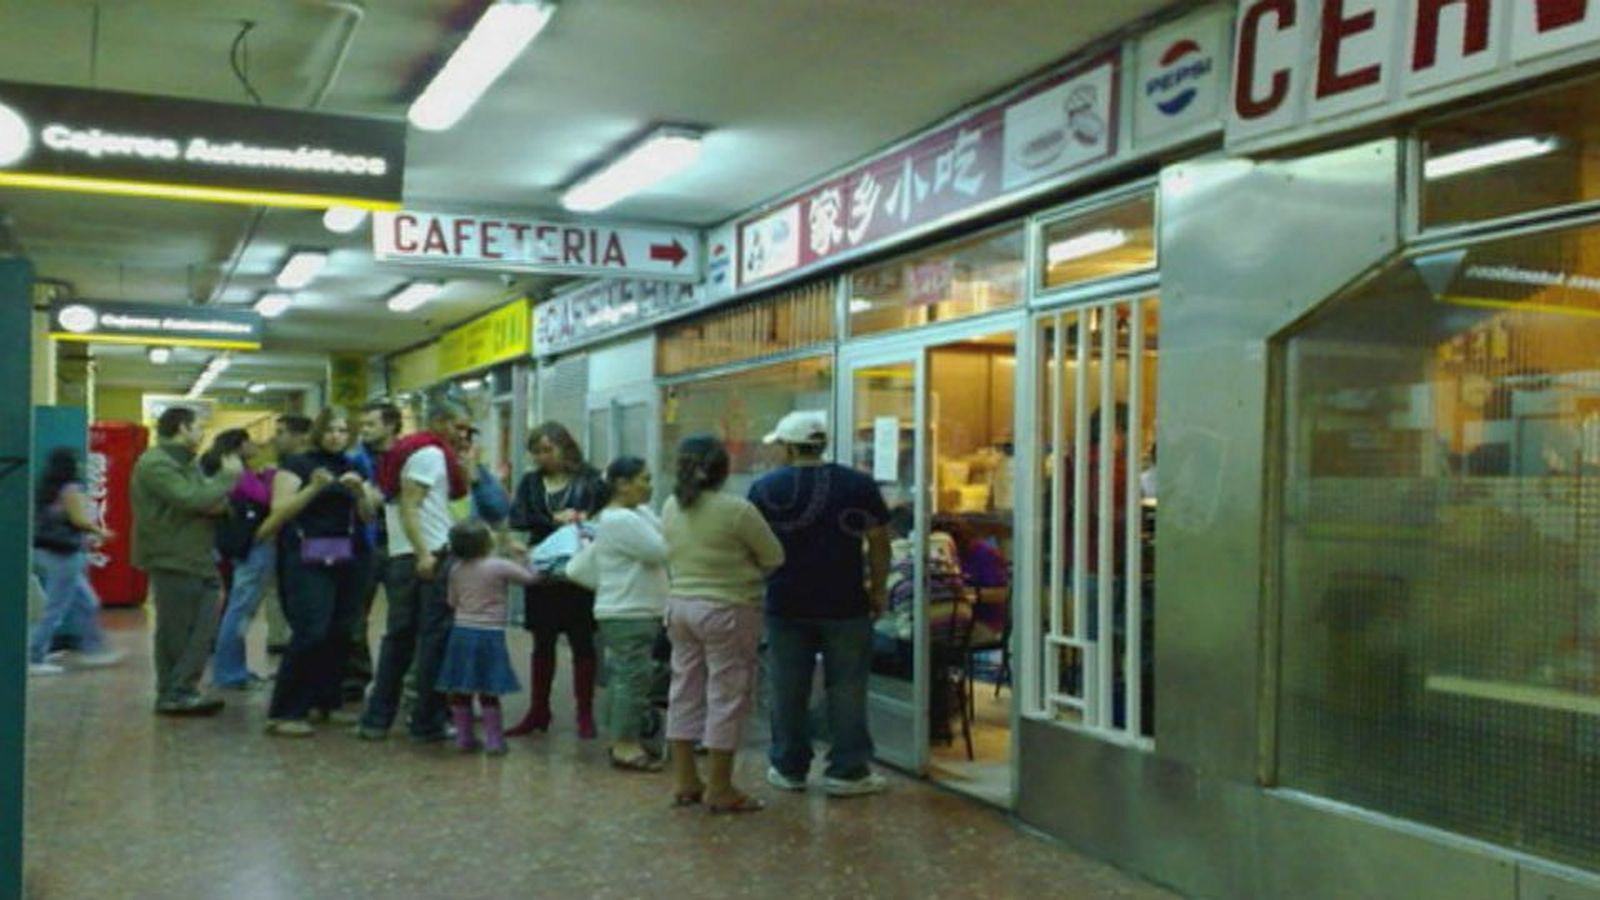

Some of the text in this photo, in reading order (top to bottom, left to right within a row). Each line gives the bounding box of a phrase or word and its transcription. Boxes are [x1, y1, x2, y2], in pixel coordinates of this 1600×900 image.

[1146, 57, 1212, 97] PEPSI
[42, 124, 180, 158] Cajeros
[809, 128, 986, 256] 家乡小吃
[394, 215, 627, 267] CAFETERIA
